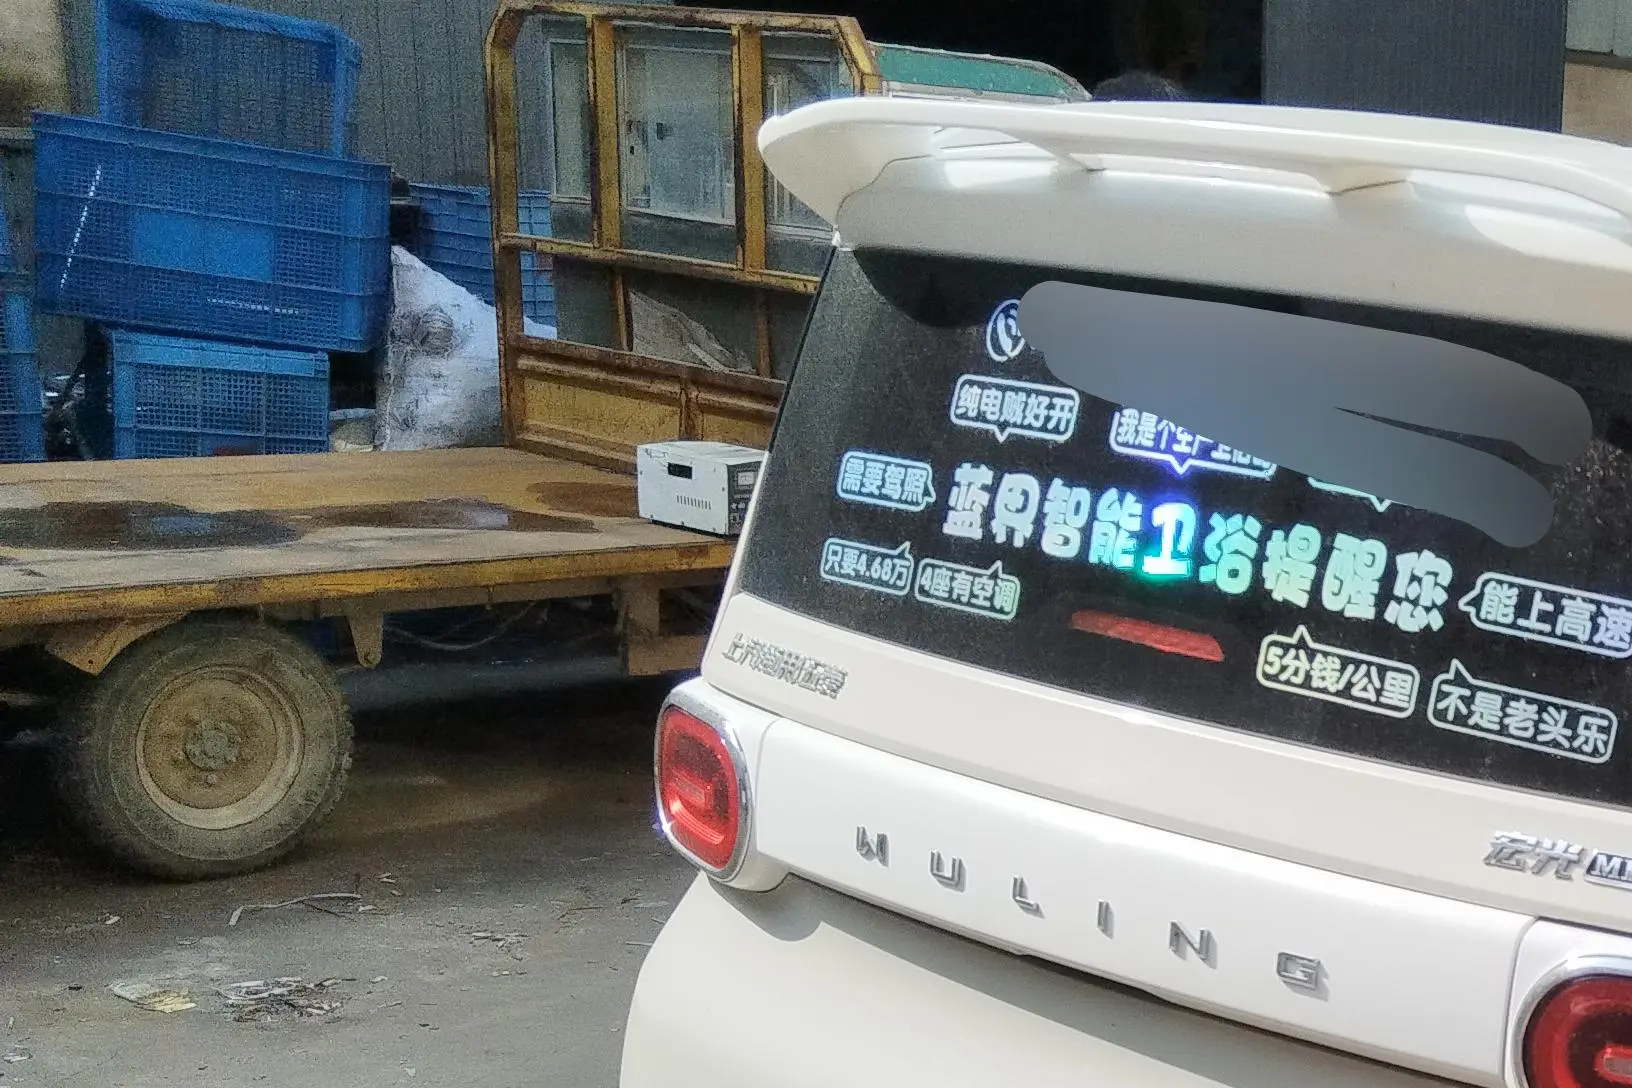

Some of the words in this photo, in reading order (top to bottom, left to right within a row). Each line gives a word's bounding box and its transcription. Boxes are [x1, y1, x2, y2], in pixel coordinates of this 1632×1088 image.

[955, 384, 1075, 432] 纯电贼好开
[842, 458, 927, 502] 需要驾照
[824, 544, 911, 587] 只要4.68万
[920, 566, 1016, 613] 4座有空调
[1263, 645, 1416, 710] 5分钱/公里
[1436, 684, 1610, 755] 不是老头乐
[855, 823, 1323, 991] WULING
